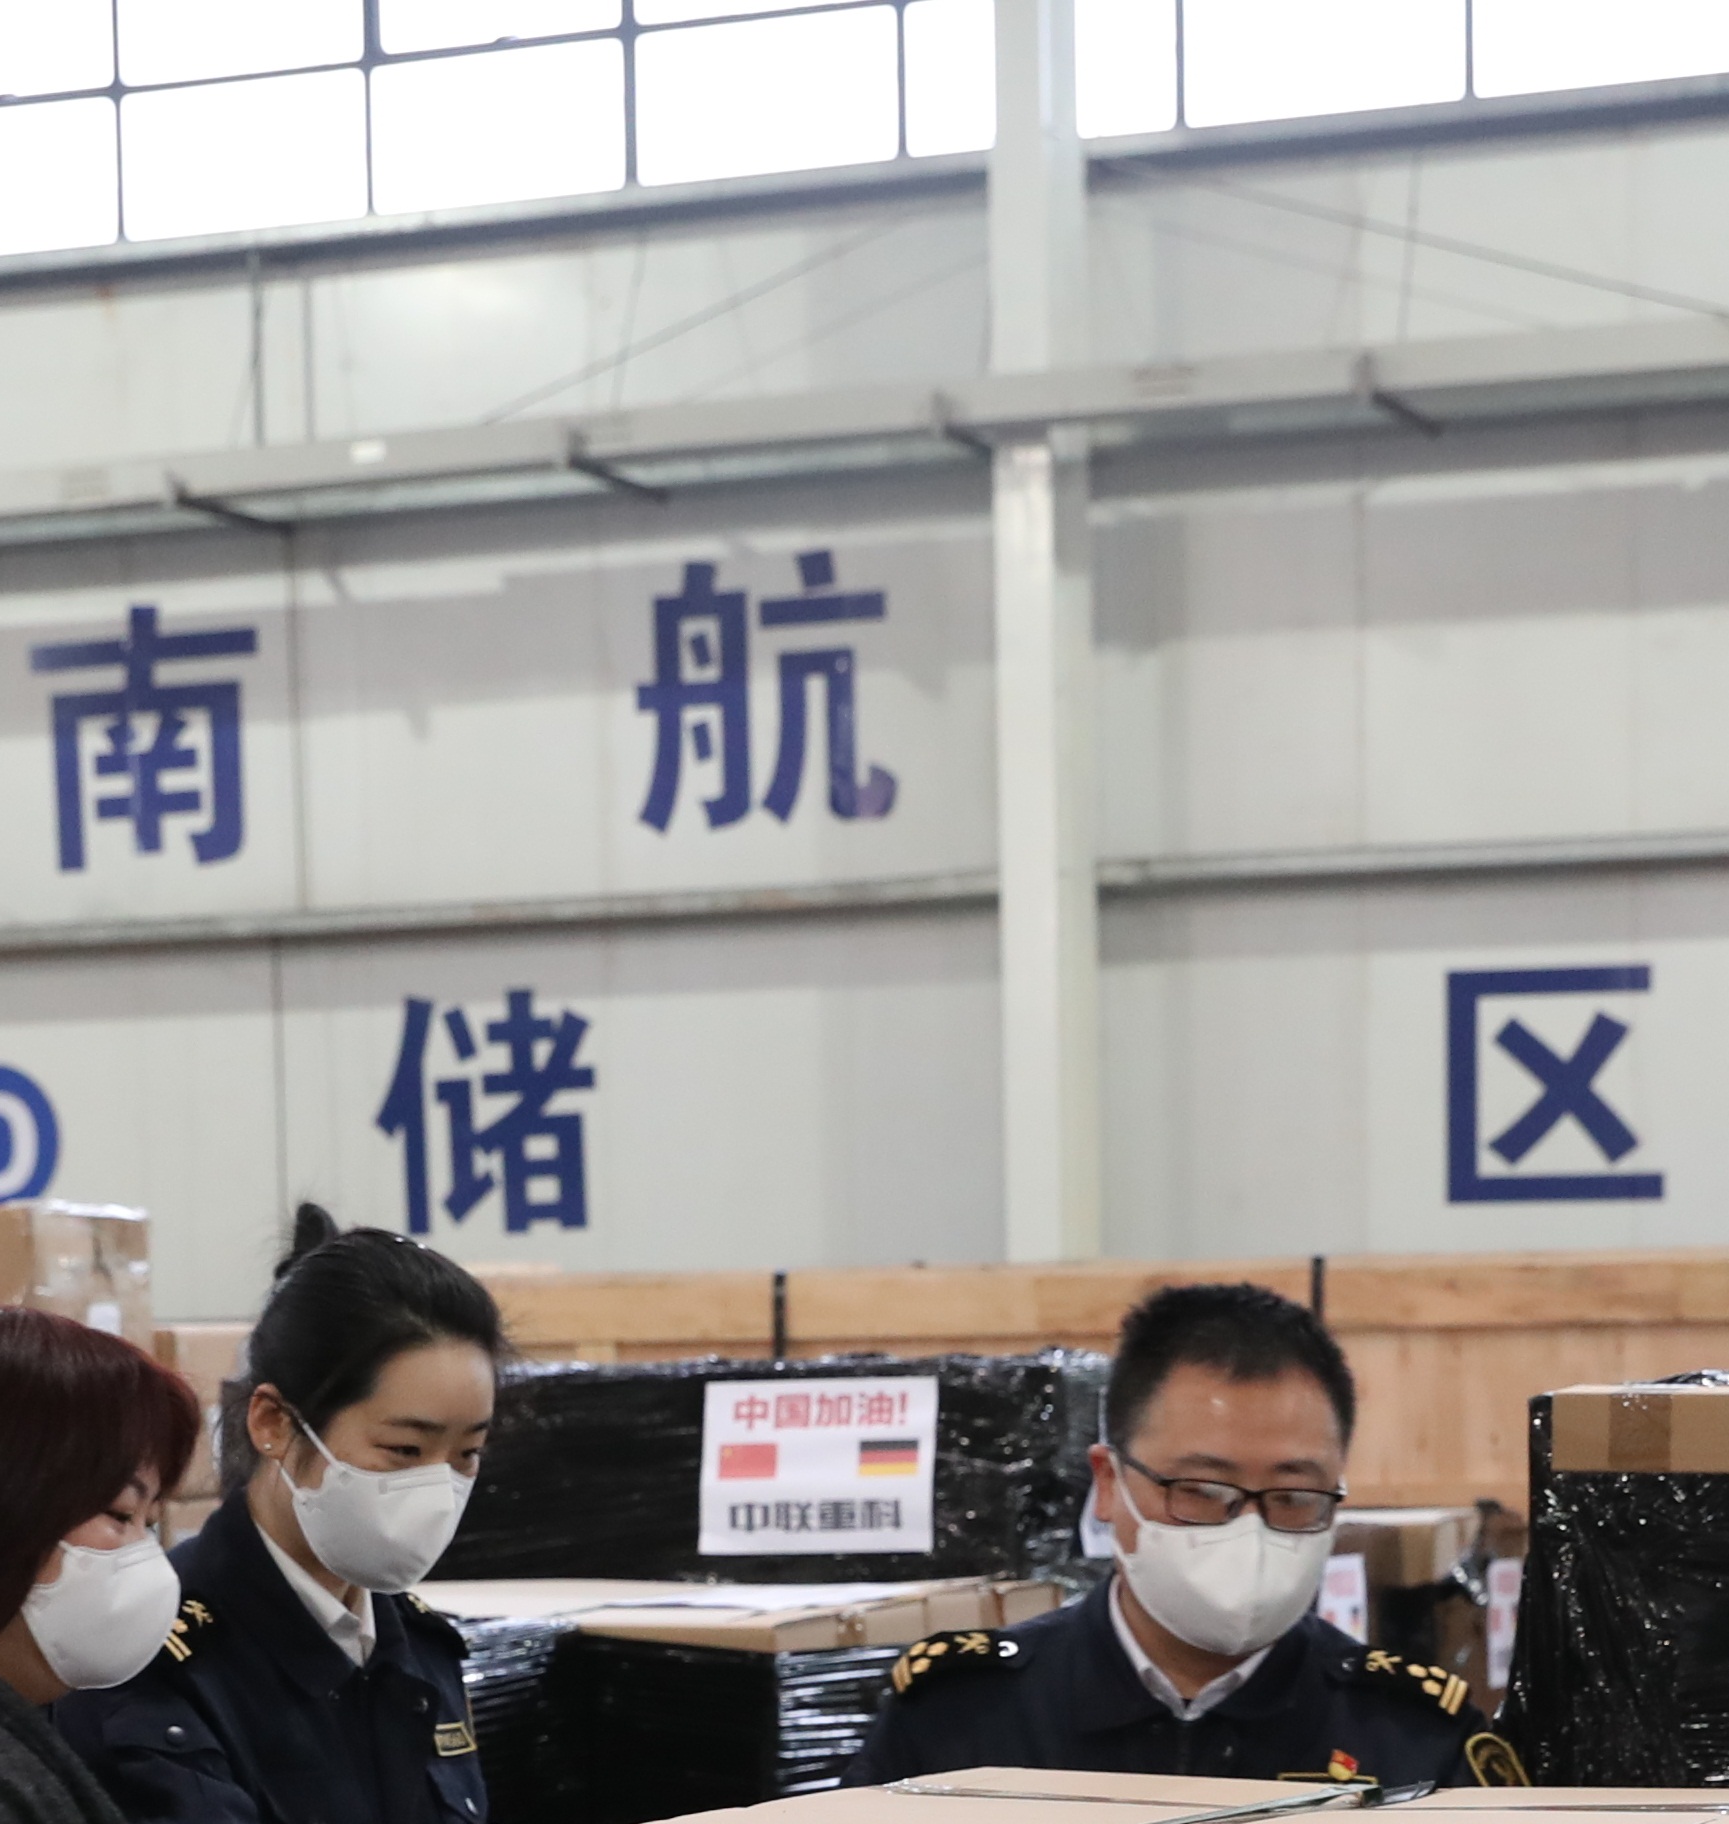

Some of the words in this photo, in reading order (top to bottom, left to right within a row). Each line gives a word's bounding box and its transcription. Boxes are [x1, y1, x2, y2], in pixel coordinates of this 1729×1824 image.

[733, 1391, 908, 1429] 中国加油!
[729, 1499, 902, 1532] 中联重科
